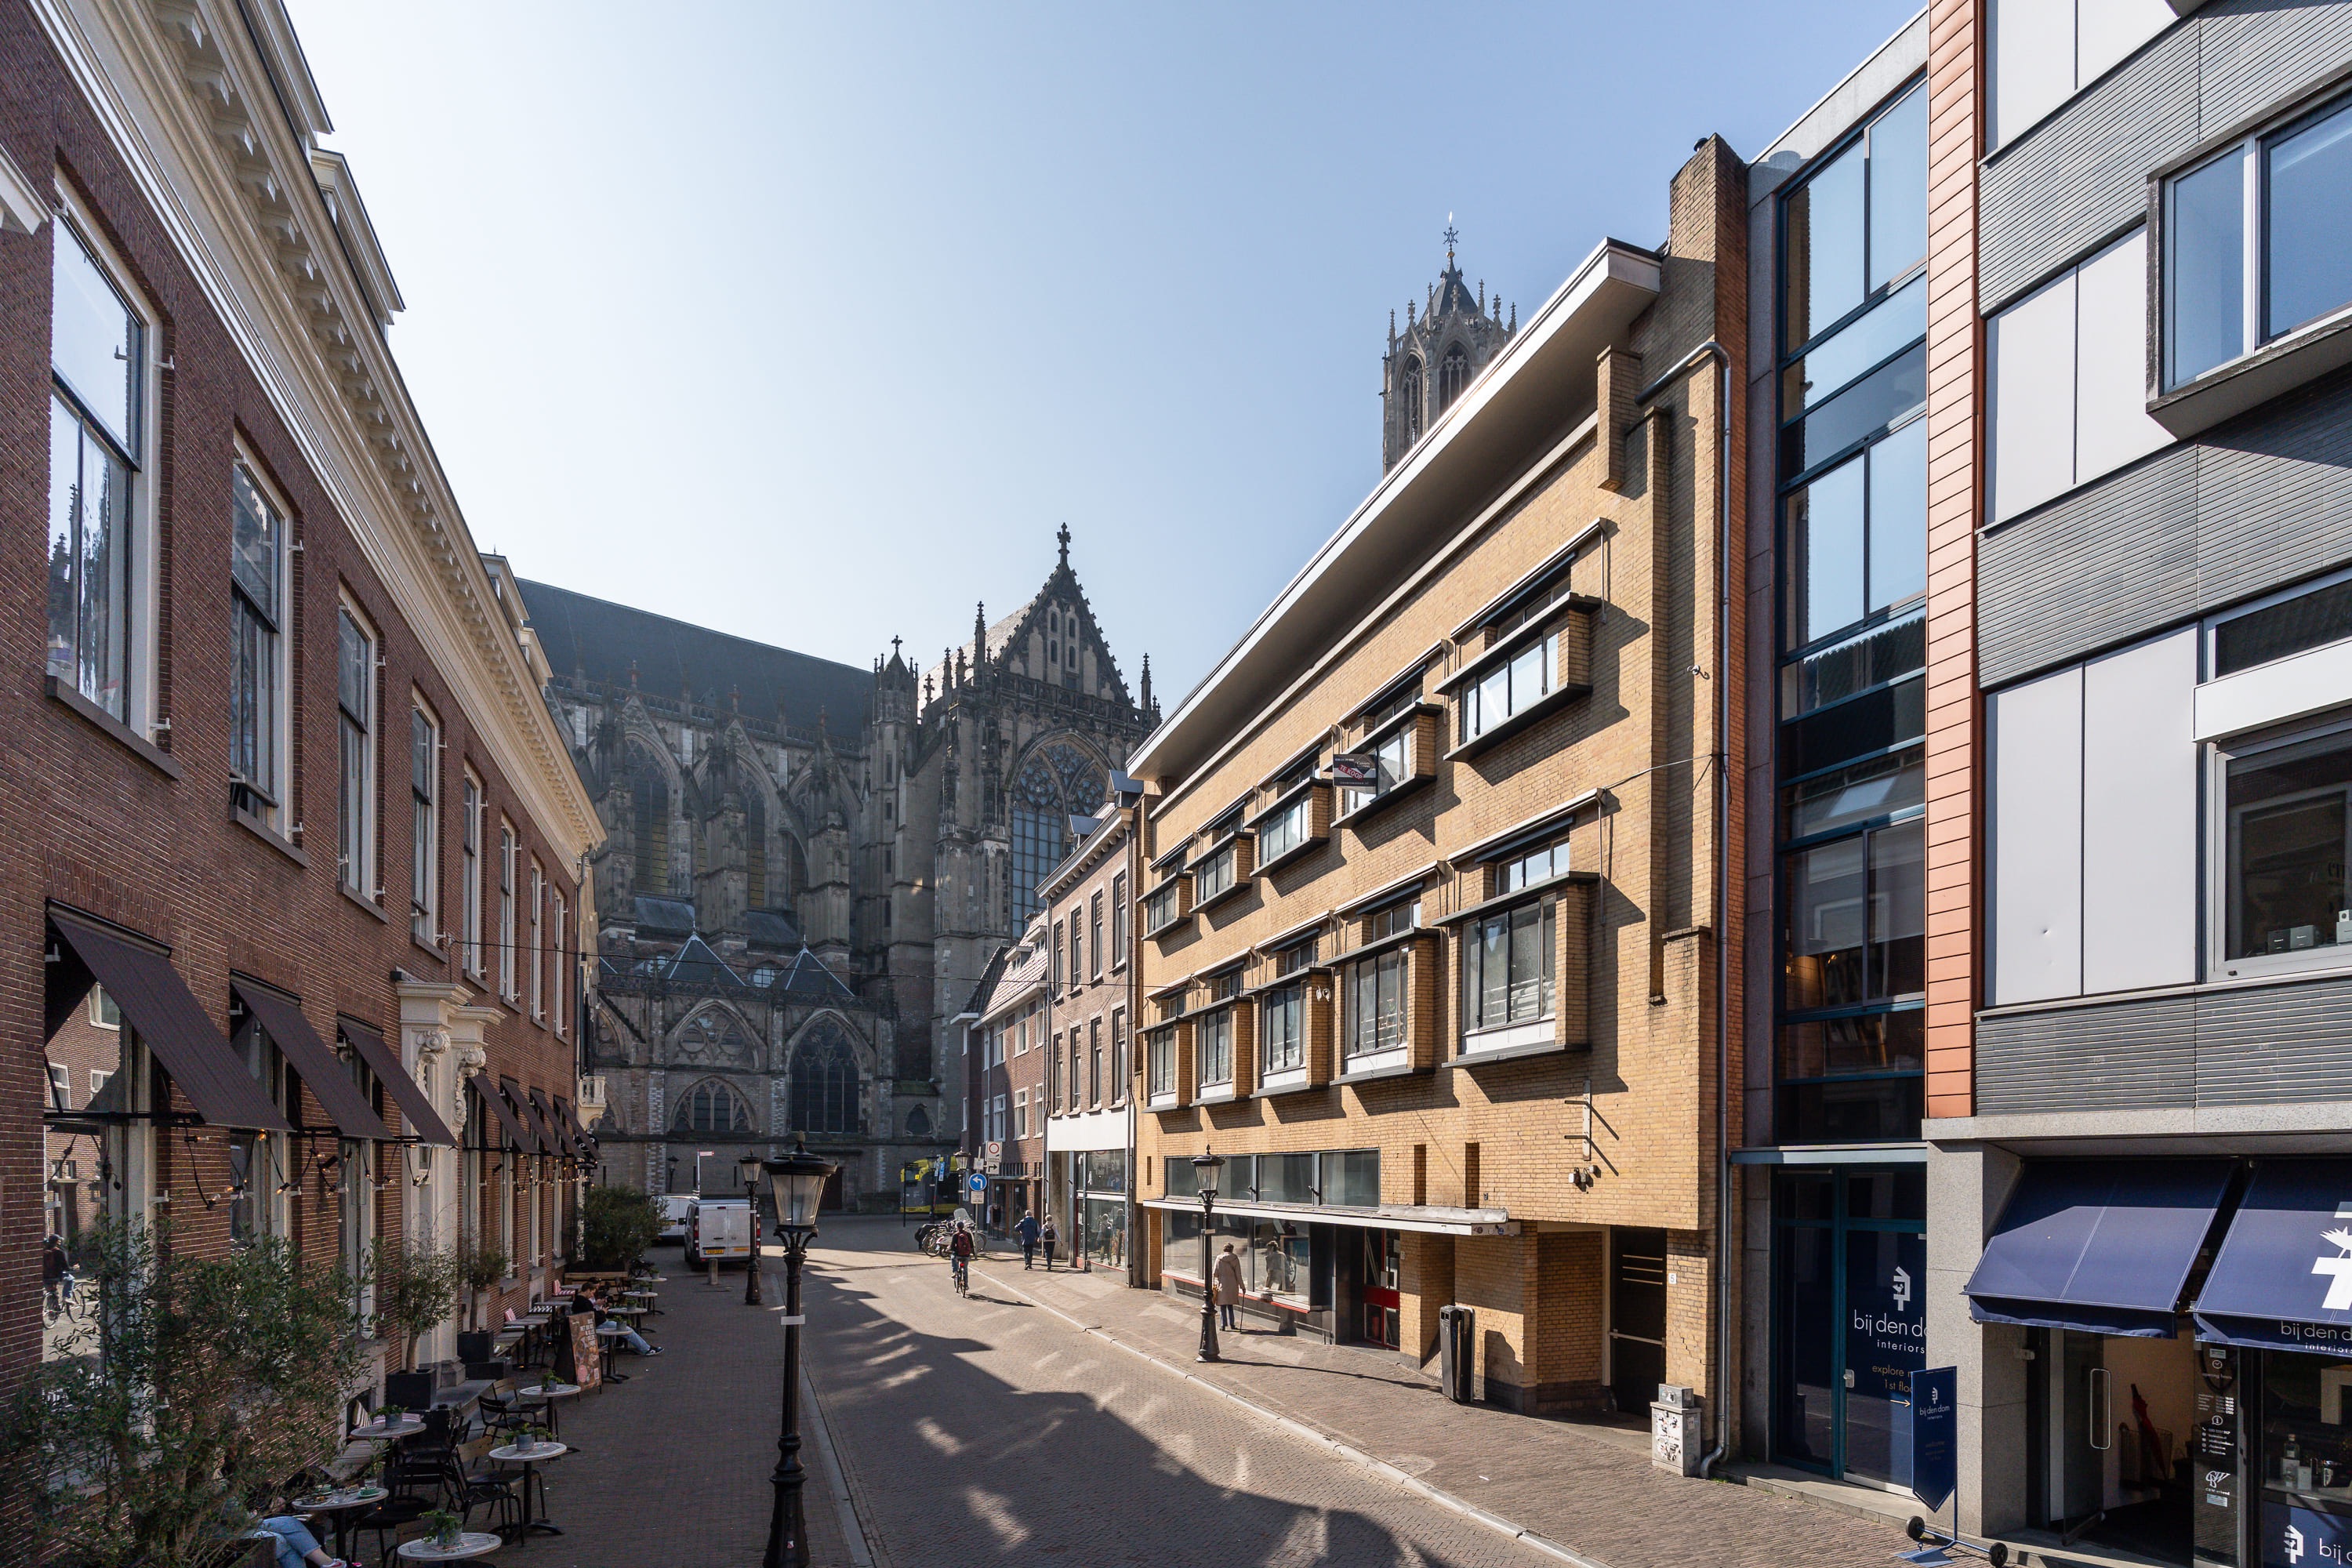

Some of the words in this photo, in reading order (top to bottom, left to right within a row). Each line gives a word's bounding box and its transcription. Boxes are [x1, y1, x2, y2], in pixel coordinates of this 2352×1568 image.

[1347, 768, 1363, 780] KOOP
[1670, 1274, 1675, 1283] 5
[1854, 1308, 1872, 1337] bij
[1875, 1312, 1907, 1335] den
[1911, 1316, 1926, 1338] d
[2281, 1320, 2299, 1341] bij
[2303, 1323, 2337, 1340] den
[1877, 1339, 1926, 1354] interiors
[1871, 1365, 1904, 1377] explore
[1884, 1379, 1896, 1390] 1st
[1926, 1406, 1937, 1414] den
[1937, 1404, 1951, 1413] dom
[2319, 1537, 2342, 1565] bij
